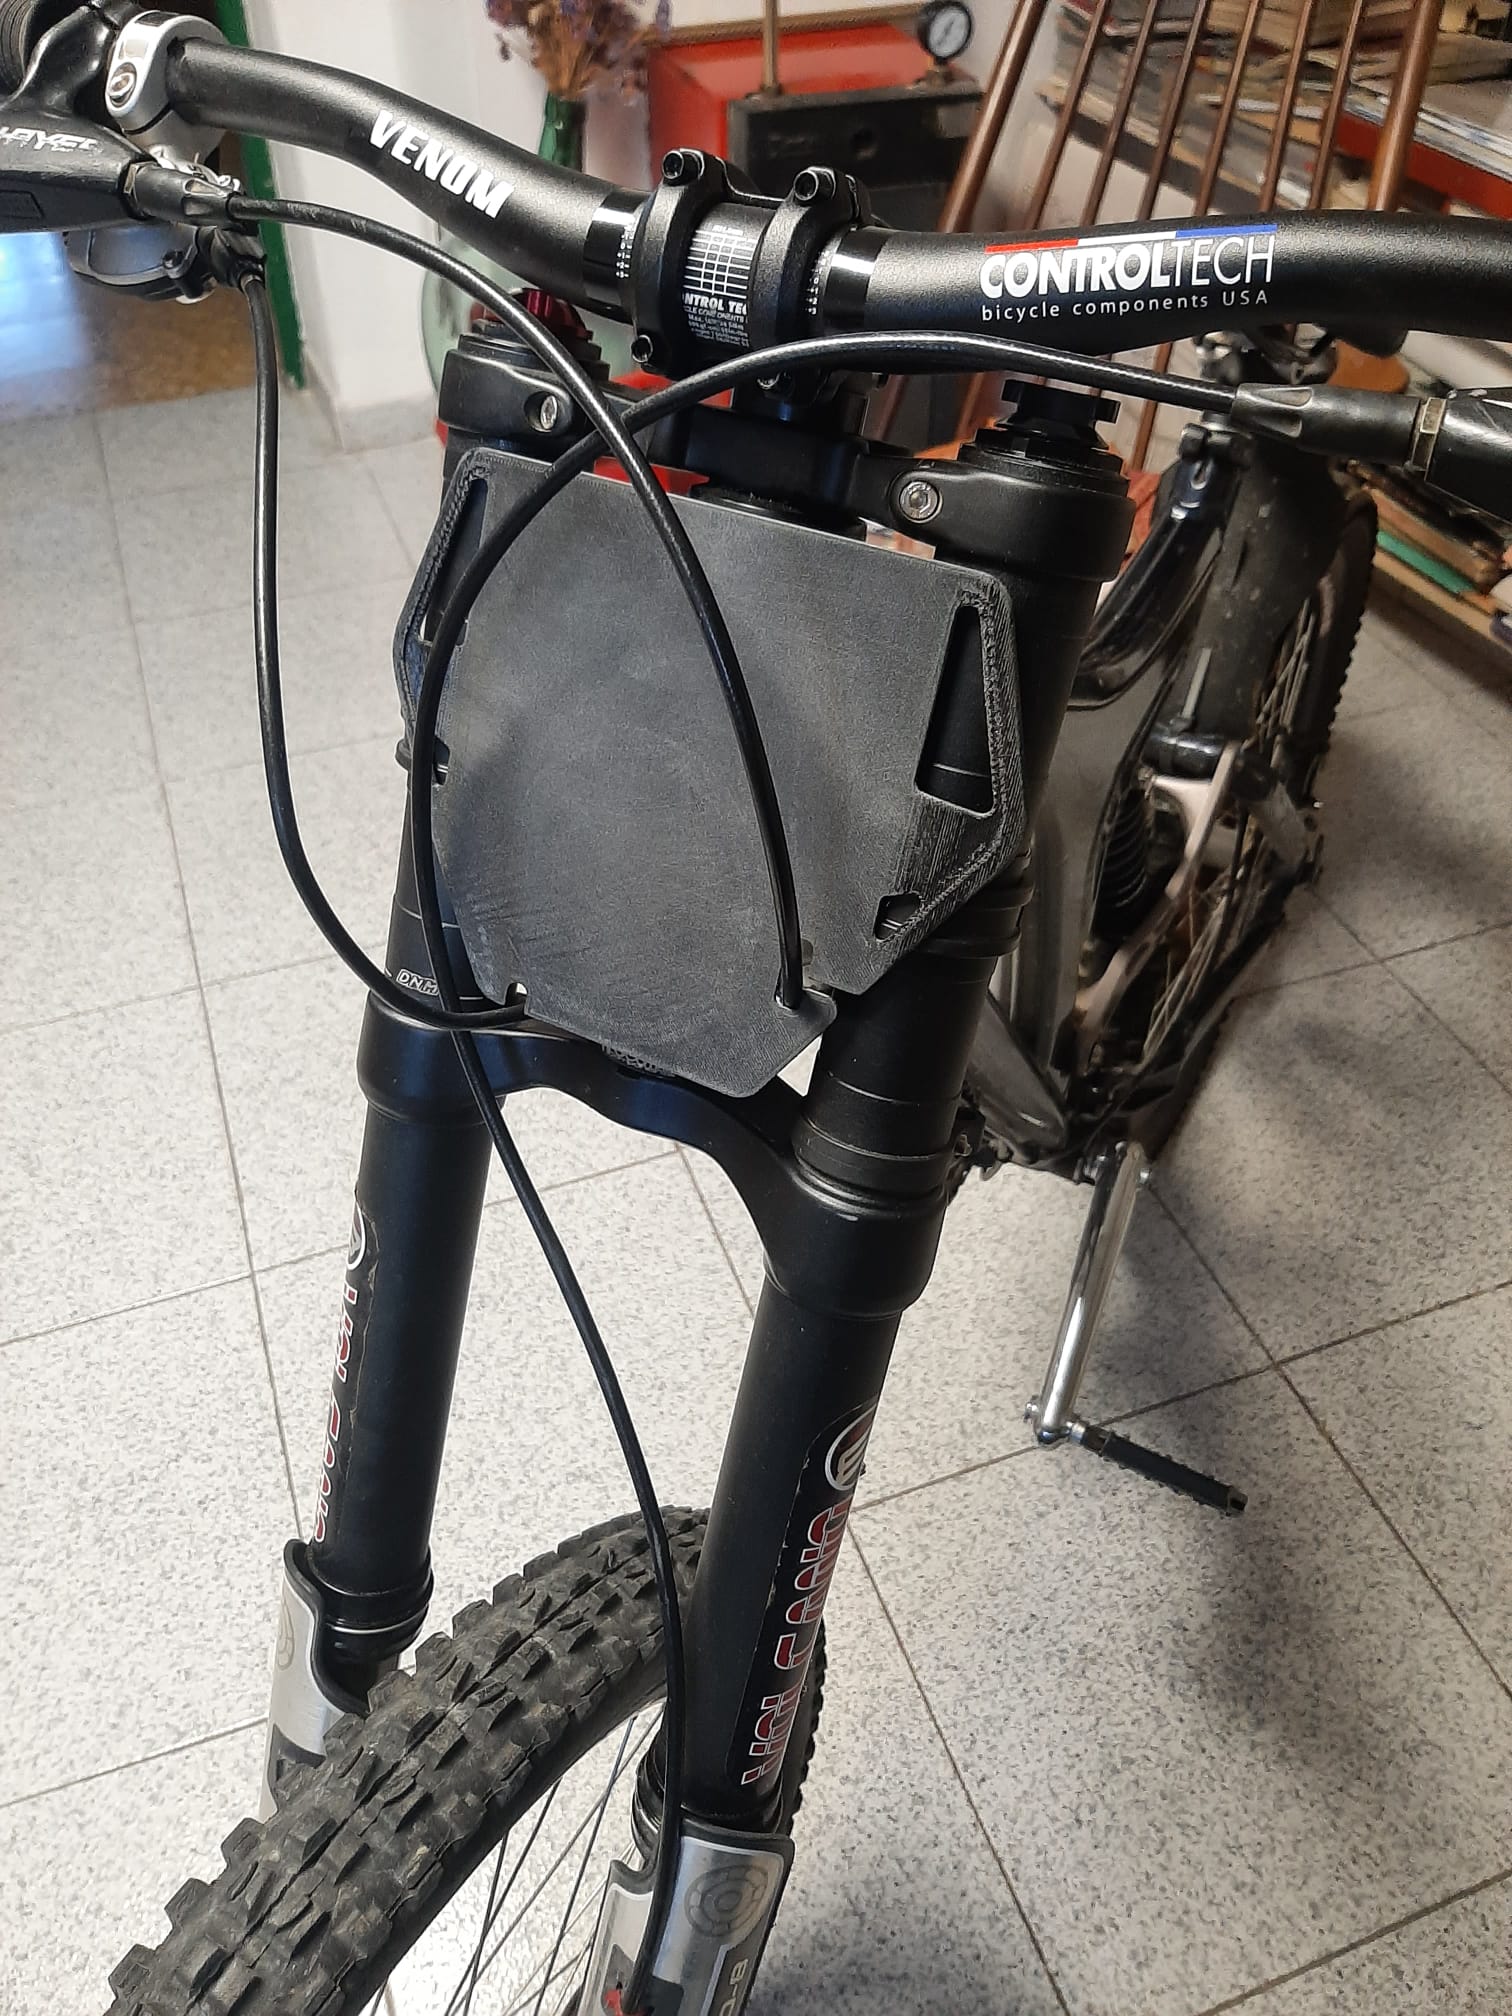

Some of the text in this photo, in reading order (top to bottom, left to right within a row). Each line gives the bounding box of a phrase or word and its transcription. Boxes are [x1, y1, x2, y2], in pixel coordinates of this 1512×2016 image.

[370, 109, 514, 219] VENOM
[980, 235, 1276, 299] CONTROLTECH
[682, 292, 725, 311] NTROL
[982, 289, 1269, 323] bicycle components USA
